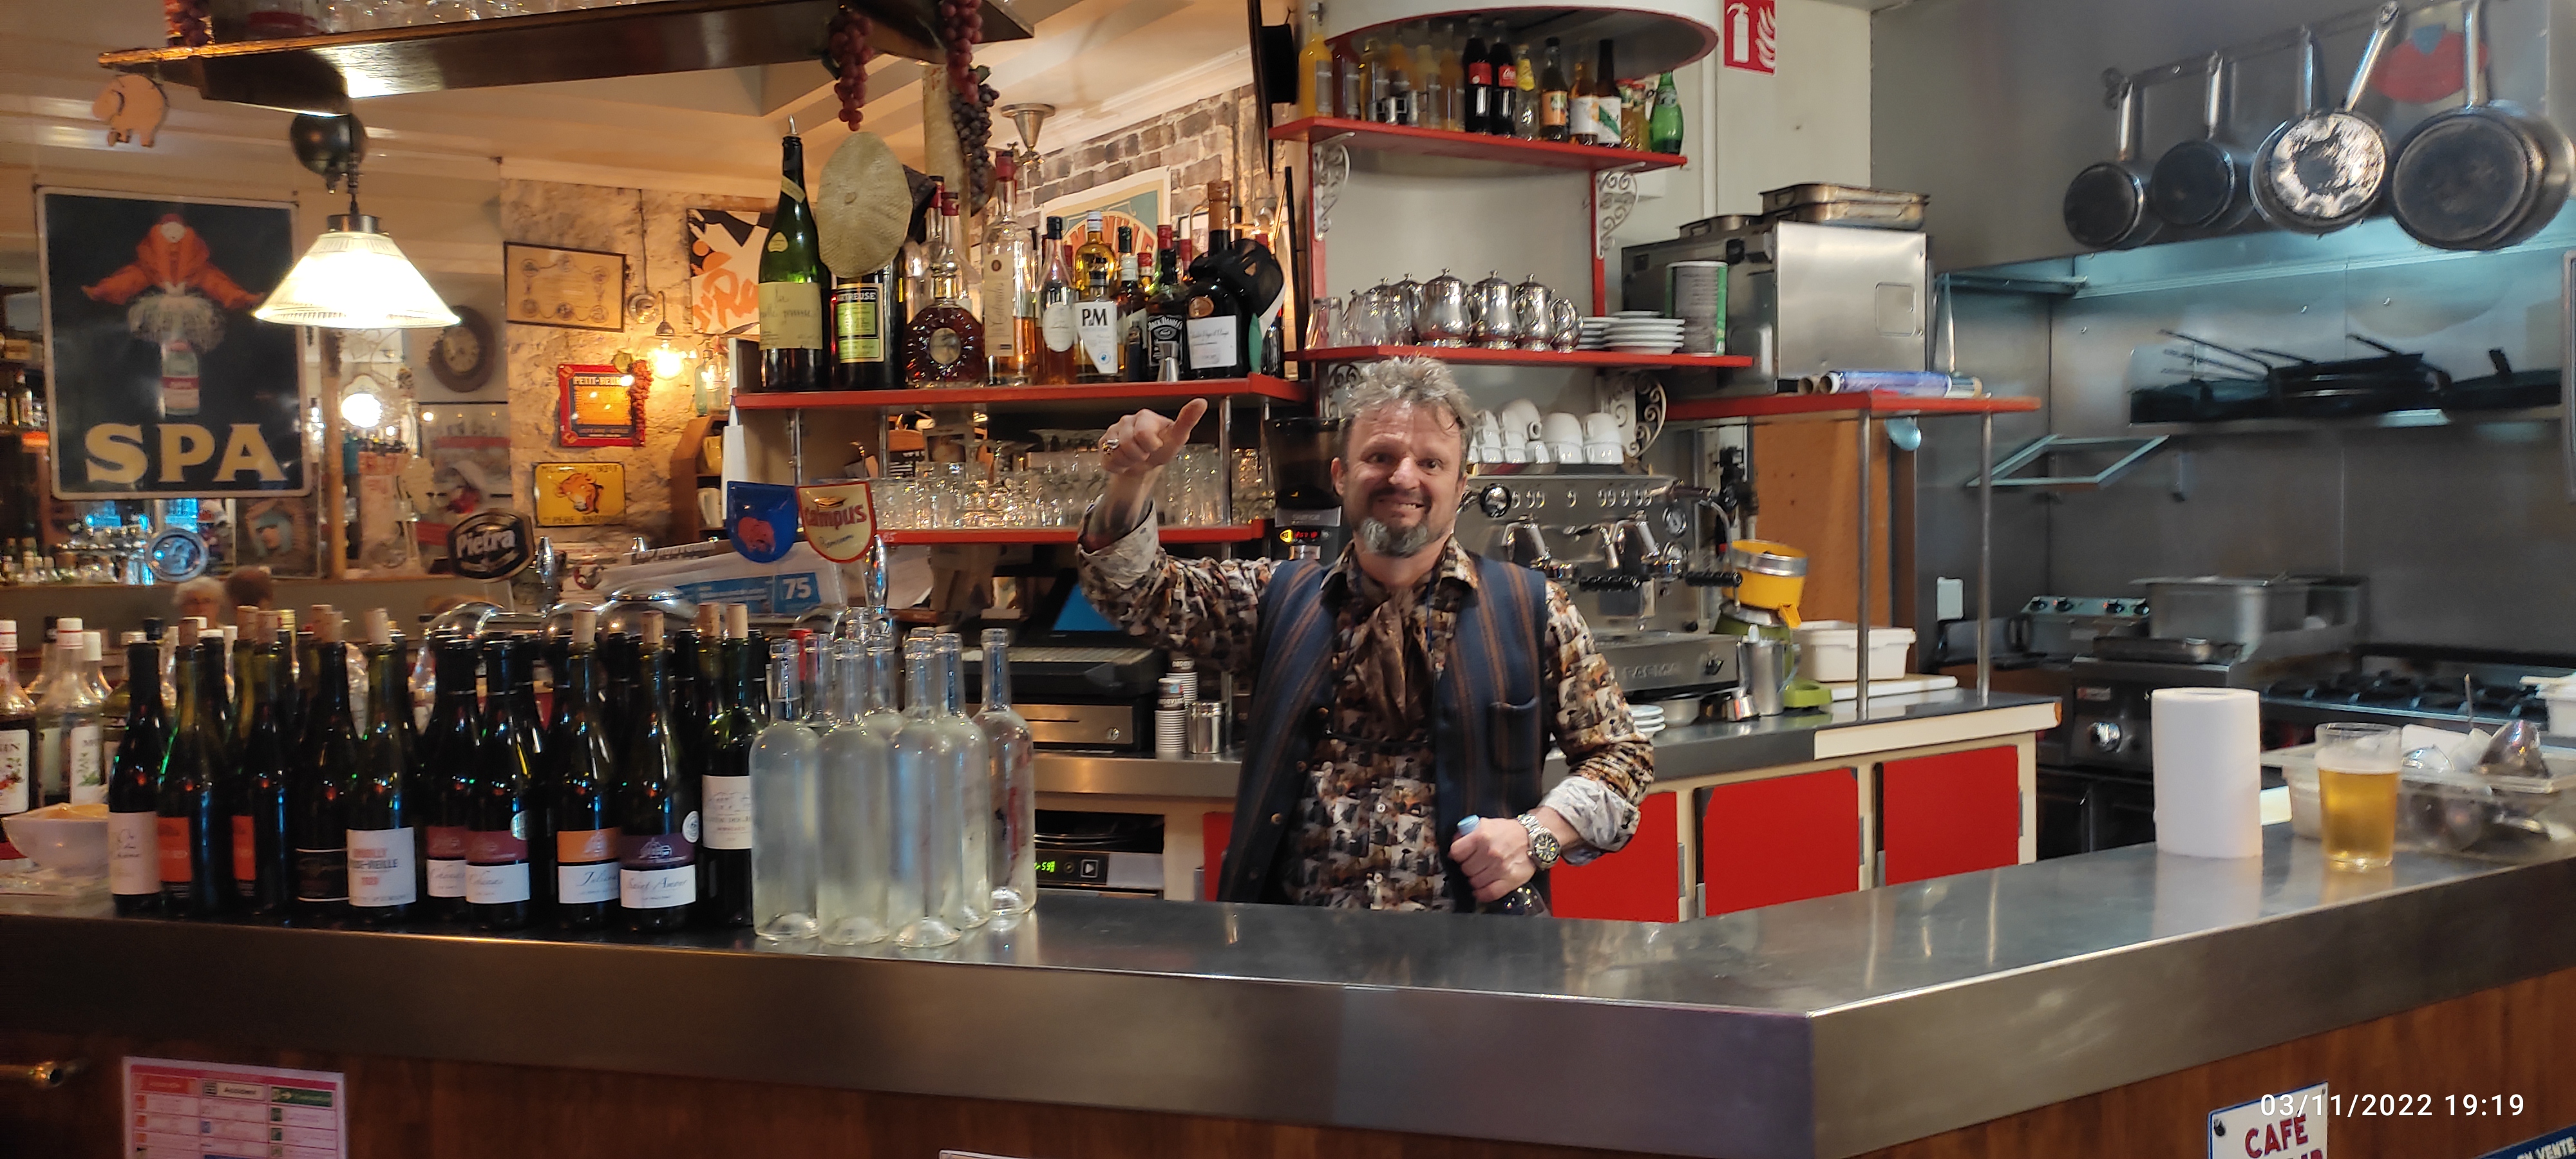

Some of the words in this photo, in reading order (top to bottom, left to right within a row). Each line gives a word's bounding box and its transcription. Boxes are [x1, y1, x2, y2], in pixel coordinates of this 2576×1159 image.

[84, 423, 288, 484] SPA
[804, 504, 867, 531] Campus
[456, 530, 515, 558] Pietra
[782, 577, 811, 599] 75
